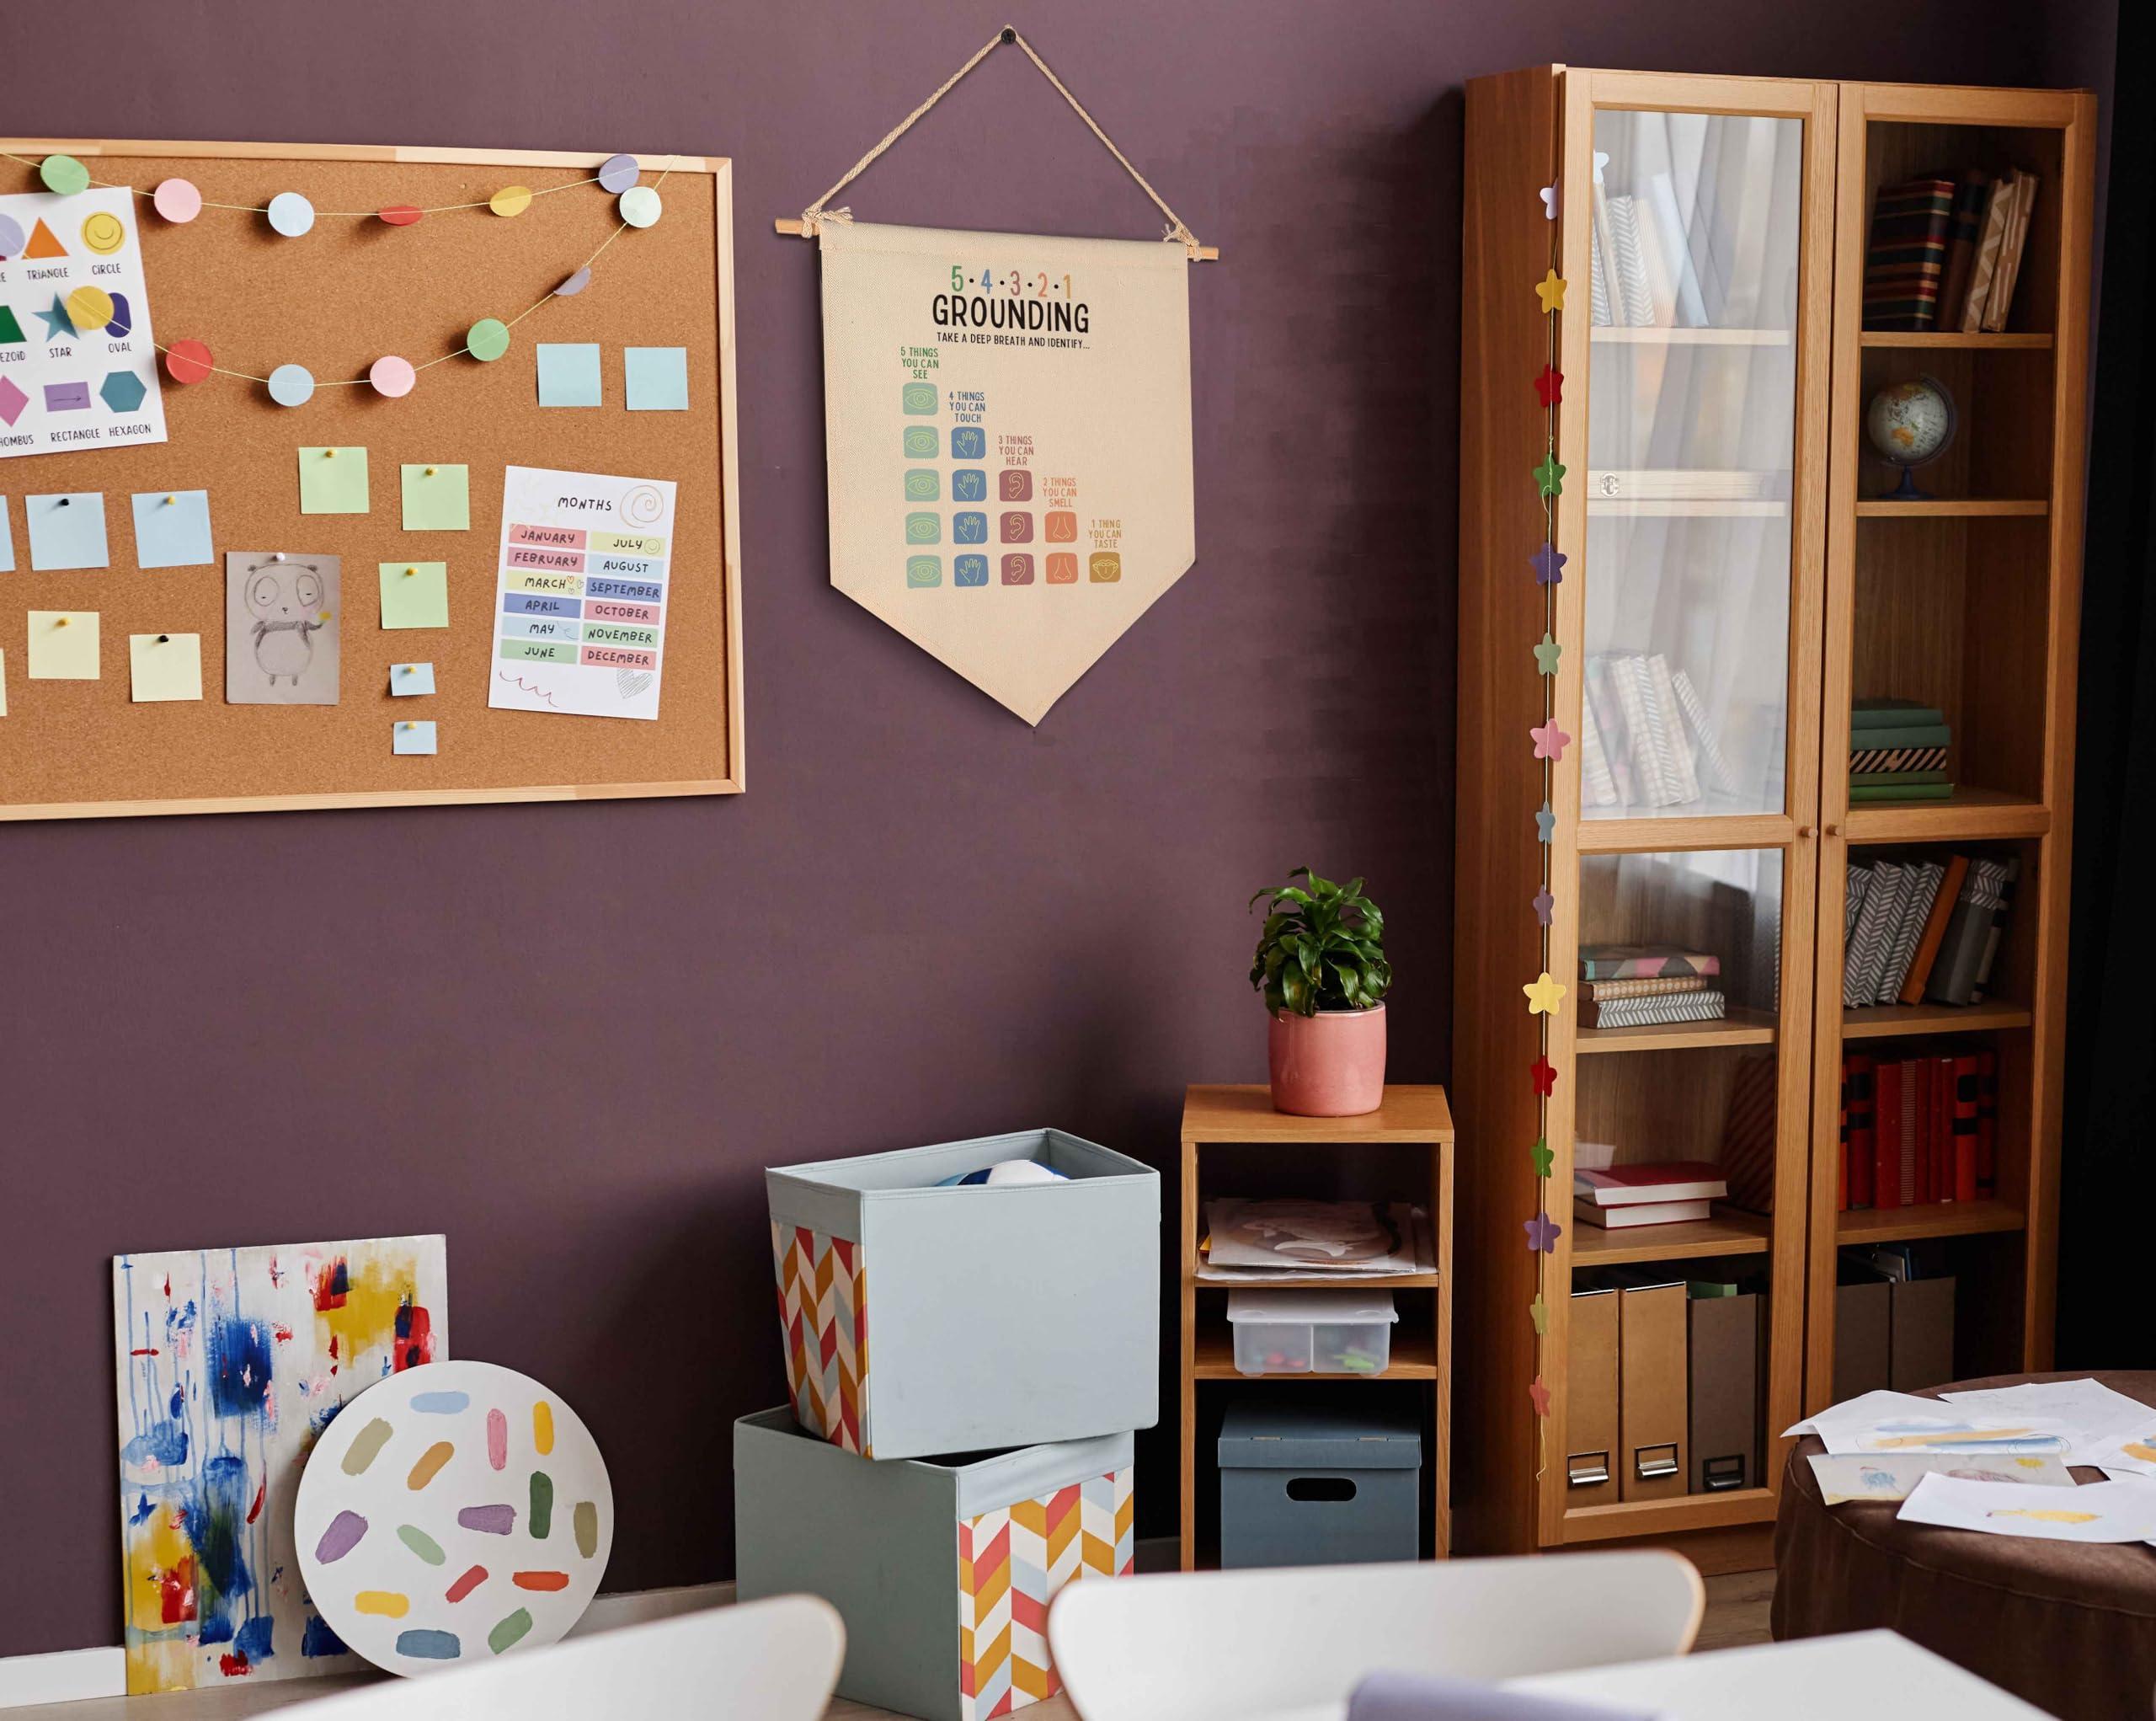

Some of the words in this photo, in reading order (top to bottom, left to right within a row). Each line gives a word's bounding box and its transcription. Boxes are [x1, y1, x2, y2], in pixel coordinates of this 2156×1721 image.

[932, 294, 1090, 334] GROUNDING
[937, 332, 959, 343] TAKE
[962, 334, 968, 343] A
[970, 334, 991, 345] DEEP
[995, 335, 1026, 346] BREATH
[1028, 337, 1046, 347] AND
[49, 347, 72, 358] STAR
[108, 342, 131, 354] OVAL
[900, 346, 906, 356] 5
[910, 347, 938, 358] THINGS
[902, 358, 918, 368] YOU
[921, 359, 939, 369] CAN
[912, 369, 928, 379] SEE
[949, 391, 954, 401] 4
[958, 391, 985, 401] THINGS
[949, 402, 967, 411] YOU
[969, 402, 985, 412] CAN
[955, 413, 982, 423] TOUCH
[51, 428, 101, 443] RECTANGLE
[109, 424, 152, 437] HEXAGON
[998, 436, 1003, 446] 3
[1006, 436, 1033, 446] THINGS
[999, 446, 1016, 456] YOU
[1017, 446, 1034, 456] CAN
[1006, 457, 1027, 466] HEAR
[1043, 478, 1048, 487] 2
[1051, 478, 1076, 487] THINGS
[1043, 488, 1059, 497] YOU
[1060, 488, 1077, 497] CAN
[558, 496, 613, 511] MONTHS
[1049, 498, 1073, 508] SMELL
[1091, 519, 1096, 528] 1
[1098, 519, 1121, 529] THING
[520, 530, 575, 543] JANUARY
[1088, 530, 1106, 539] YOU
[1107, 530, 1122, 539] CAN
[613, 539, 643, 549] JULY
[1094, 539, 1118, 548] TASTE
[515, 552, 578, 567] FEBRUARY
[603, 560, 648, 573] AUGUST
[525, 577, 566, 590] MARCH
[590, 582, 659, 598] SEPTEMBER
[526, 600, 560, 612] APRIL
[595, 605, 648, 620] OCTOBER
[529, 623, 555, 634] MAY
[588, 628, 653, 643] NOVEMBER
[525, 646, 555, 658] JUNE
[588, 650, 649, 665] DECEMBER
